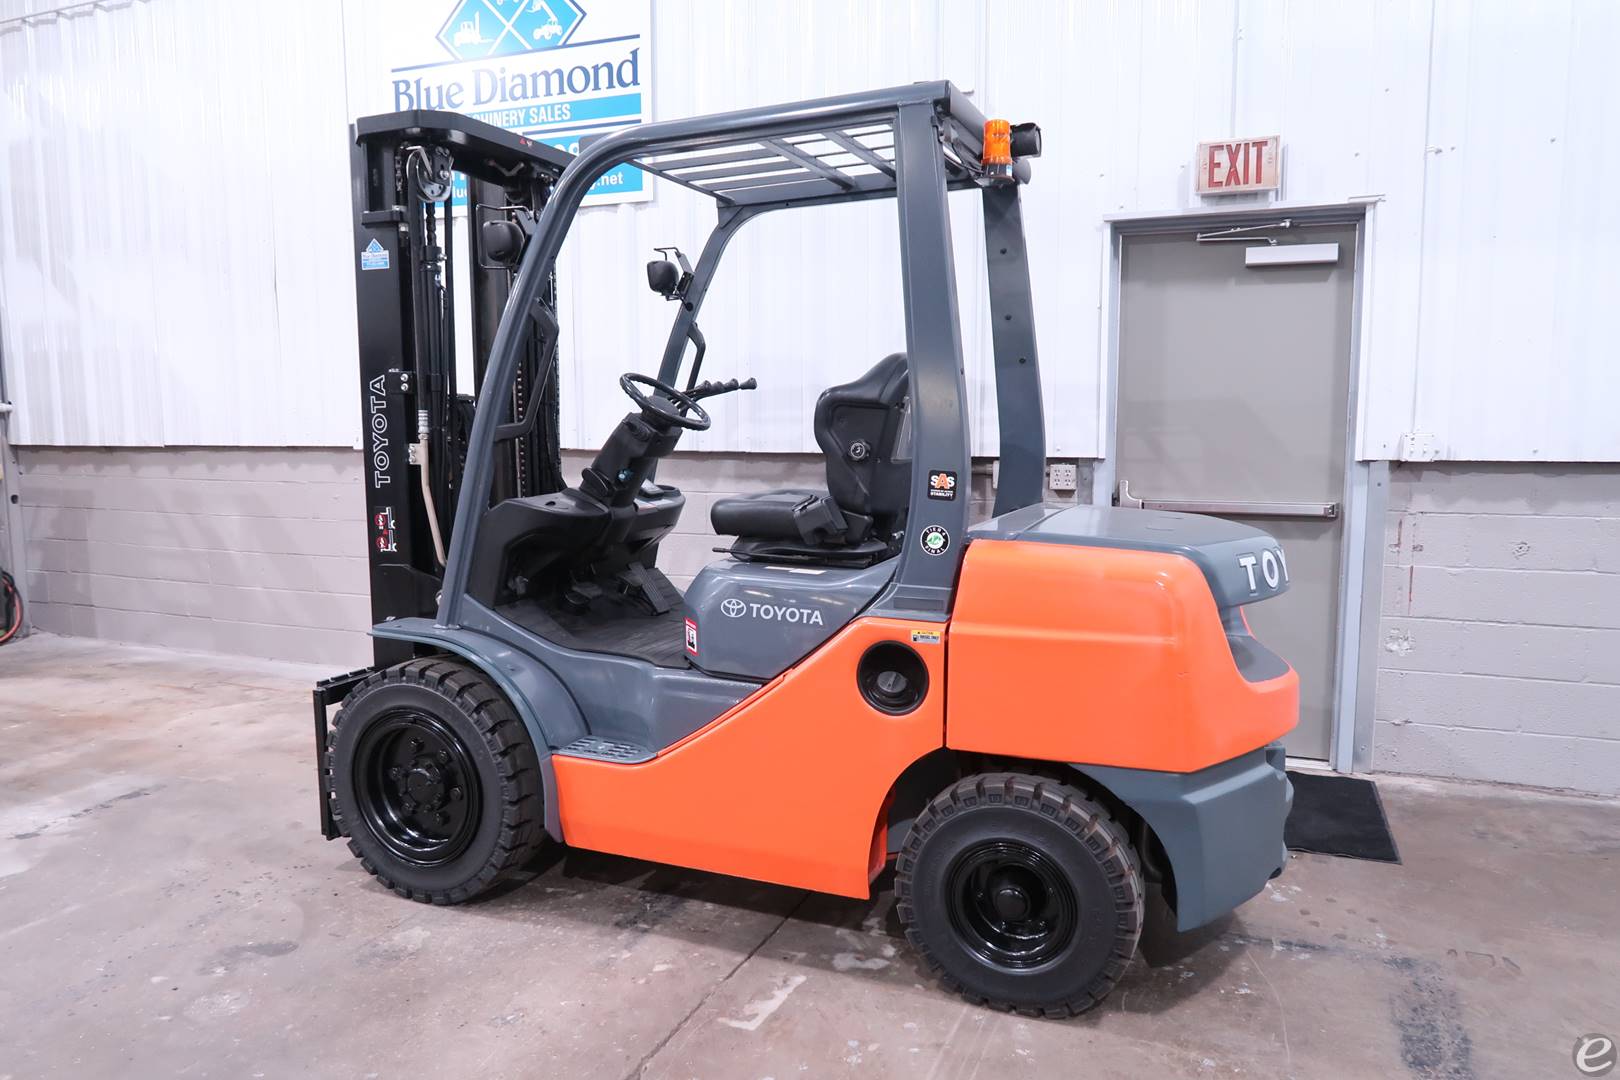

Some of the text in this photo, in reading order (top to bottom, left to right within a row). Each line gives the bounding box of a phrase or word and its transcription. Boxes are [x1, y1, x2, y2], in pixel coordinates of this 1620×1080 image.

[392, 47, 640, 112] Blue Diamond
[529, 103, 571, 123] SALES
[1208, 140, 1268, 188] EXIT
[370, 374, 391, 489] TOYOTA
[930, 473, 955, 489] SAS
[749, 603, 824, 626] TOYOTA
